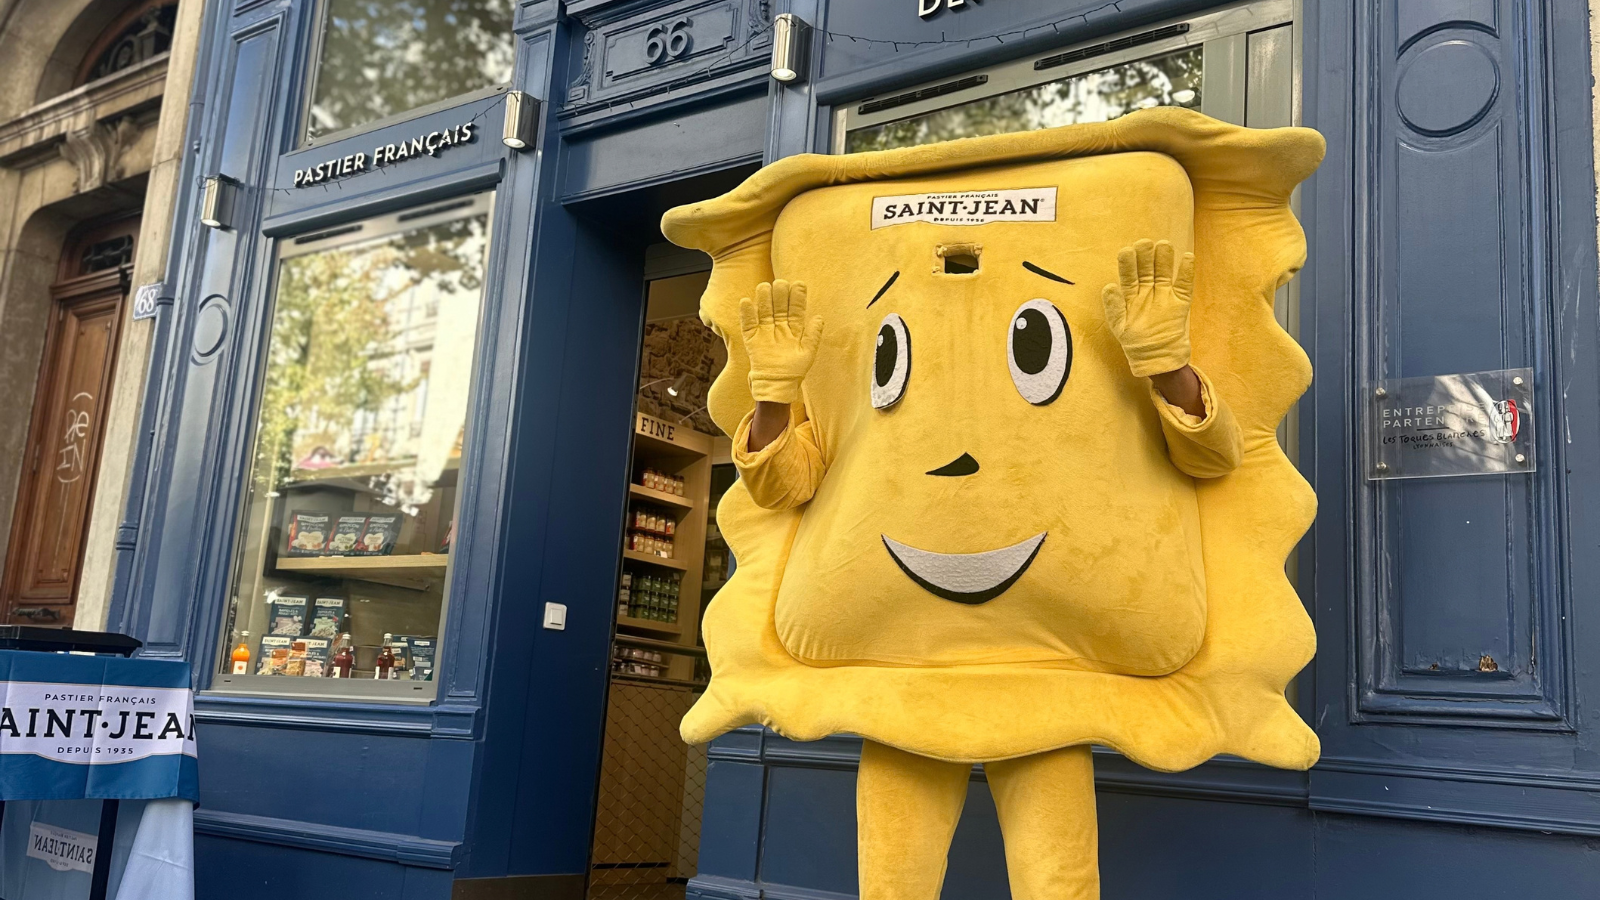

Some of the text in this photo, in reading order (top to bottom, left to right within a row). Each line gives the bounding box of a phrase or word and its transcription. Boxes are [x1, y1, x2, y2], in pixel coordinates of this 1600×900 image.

[645, 16, 693, 64] 66
[293, 122, 474, 187] PASTIER FRANÇAIS
[138, 288, 158, 314] 68
[640, 416, 676, 441] FINE
[45, 693, 156, 706] PASTIER FRANÇAIS
[57, 746, 134, 755] DEPUIS 1935
